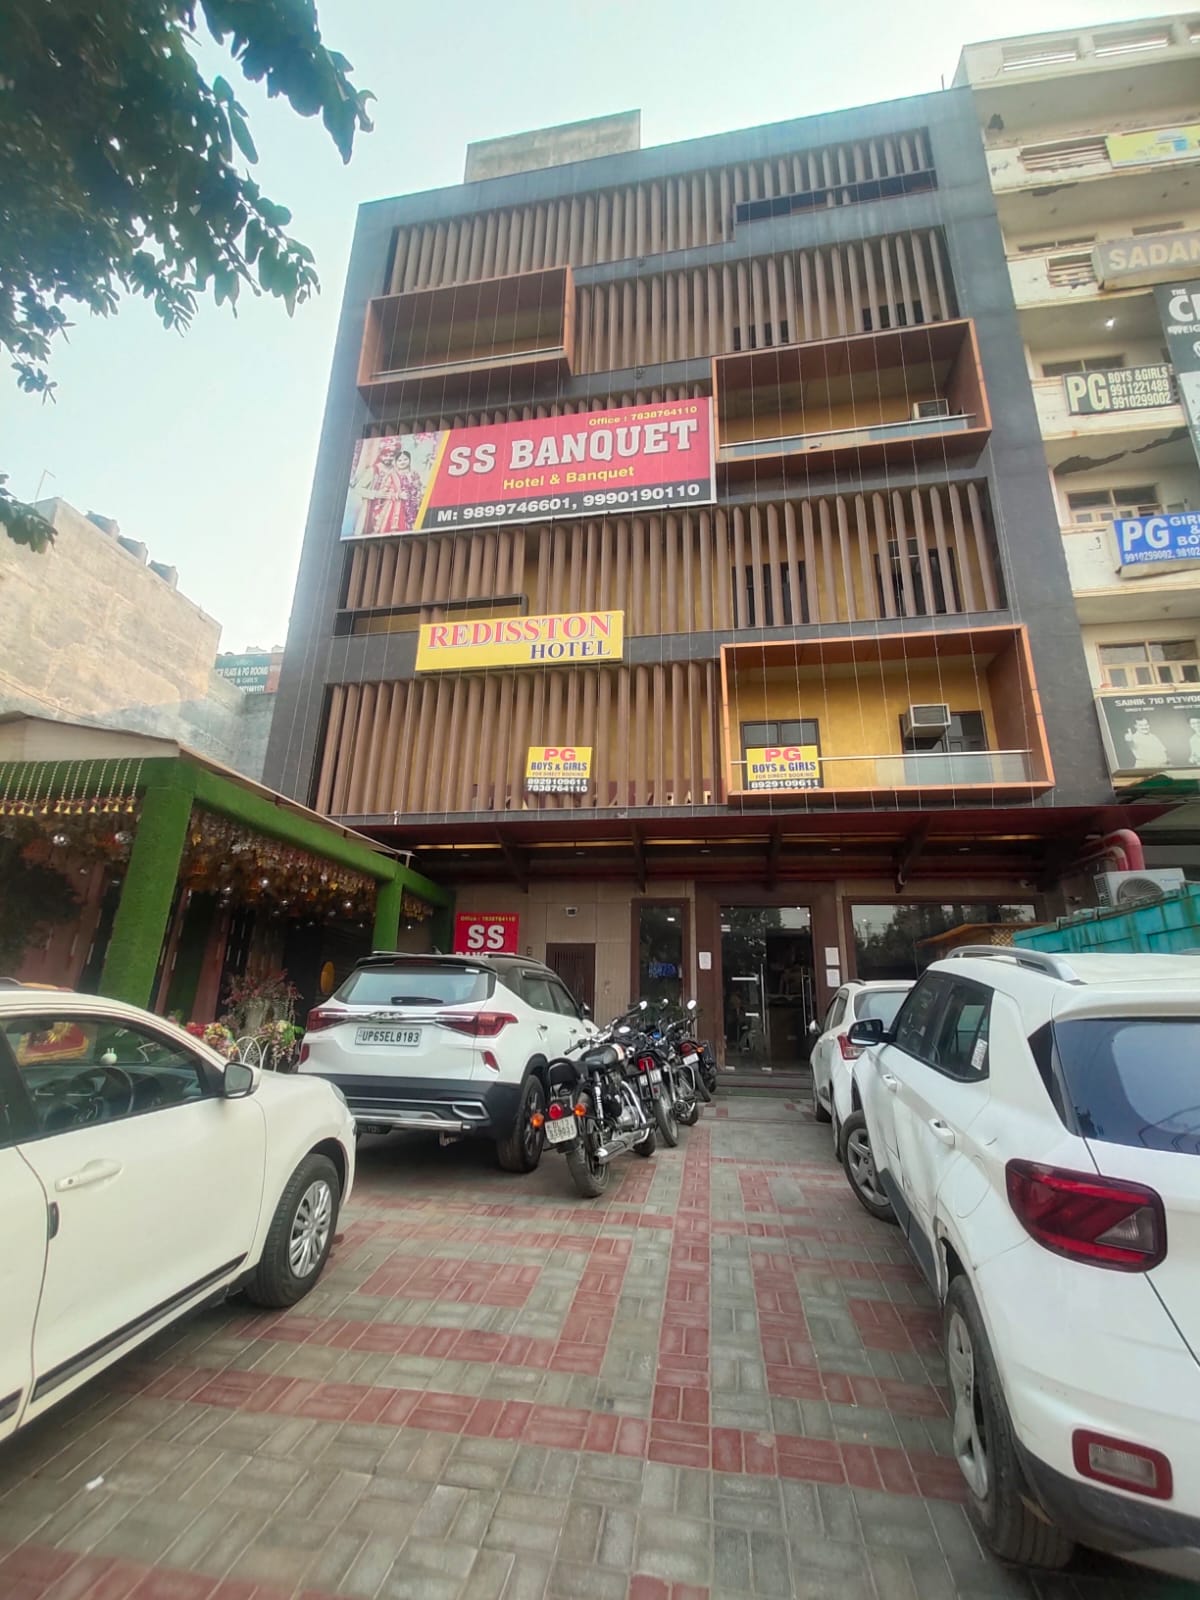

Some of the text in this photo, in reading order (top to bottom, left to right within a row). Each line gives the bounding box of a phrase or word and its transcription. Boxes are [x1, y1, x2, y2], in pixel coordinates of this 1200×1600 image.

[1108, 371, 1133, 384] BOYS
[1066, 373, 1111, 412] PG
[1109, 379, 1169, 397] 9911221489
[1112, 392, 1173, 409] 9910299002
[589, 416, 621, 426] Office
[631, 405, 698, 421] 7838764110
[448, 418, 698, 476] SS BANQUET
[503, 466, 635, 490] Hotel & Banquet
[437, 484, 700, 522] M: 9899746601, 9990190110
[1122, 518, 1169, 551] PG
[428, 614, 613, 649] REDISSTON
[529, 640, 610, 659] HOTEL
[1114, 698, 1146, 706] SAINIK
[1148, 697, 1164, 705] 710
[544, 748, 576, 761] PG
[765, 747, 801, 762] PG
[531, 762, 553, 770] BOYS
[563, 762, 587, 771] GIRLS
[752, 764, 777, 773] BOYS
[788, 761, 816, 772] GIRLS
[467, 924, 505, 949] SS
